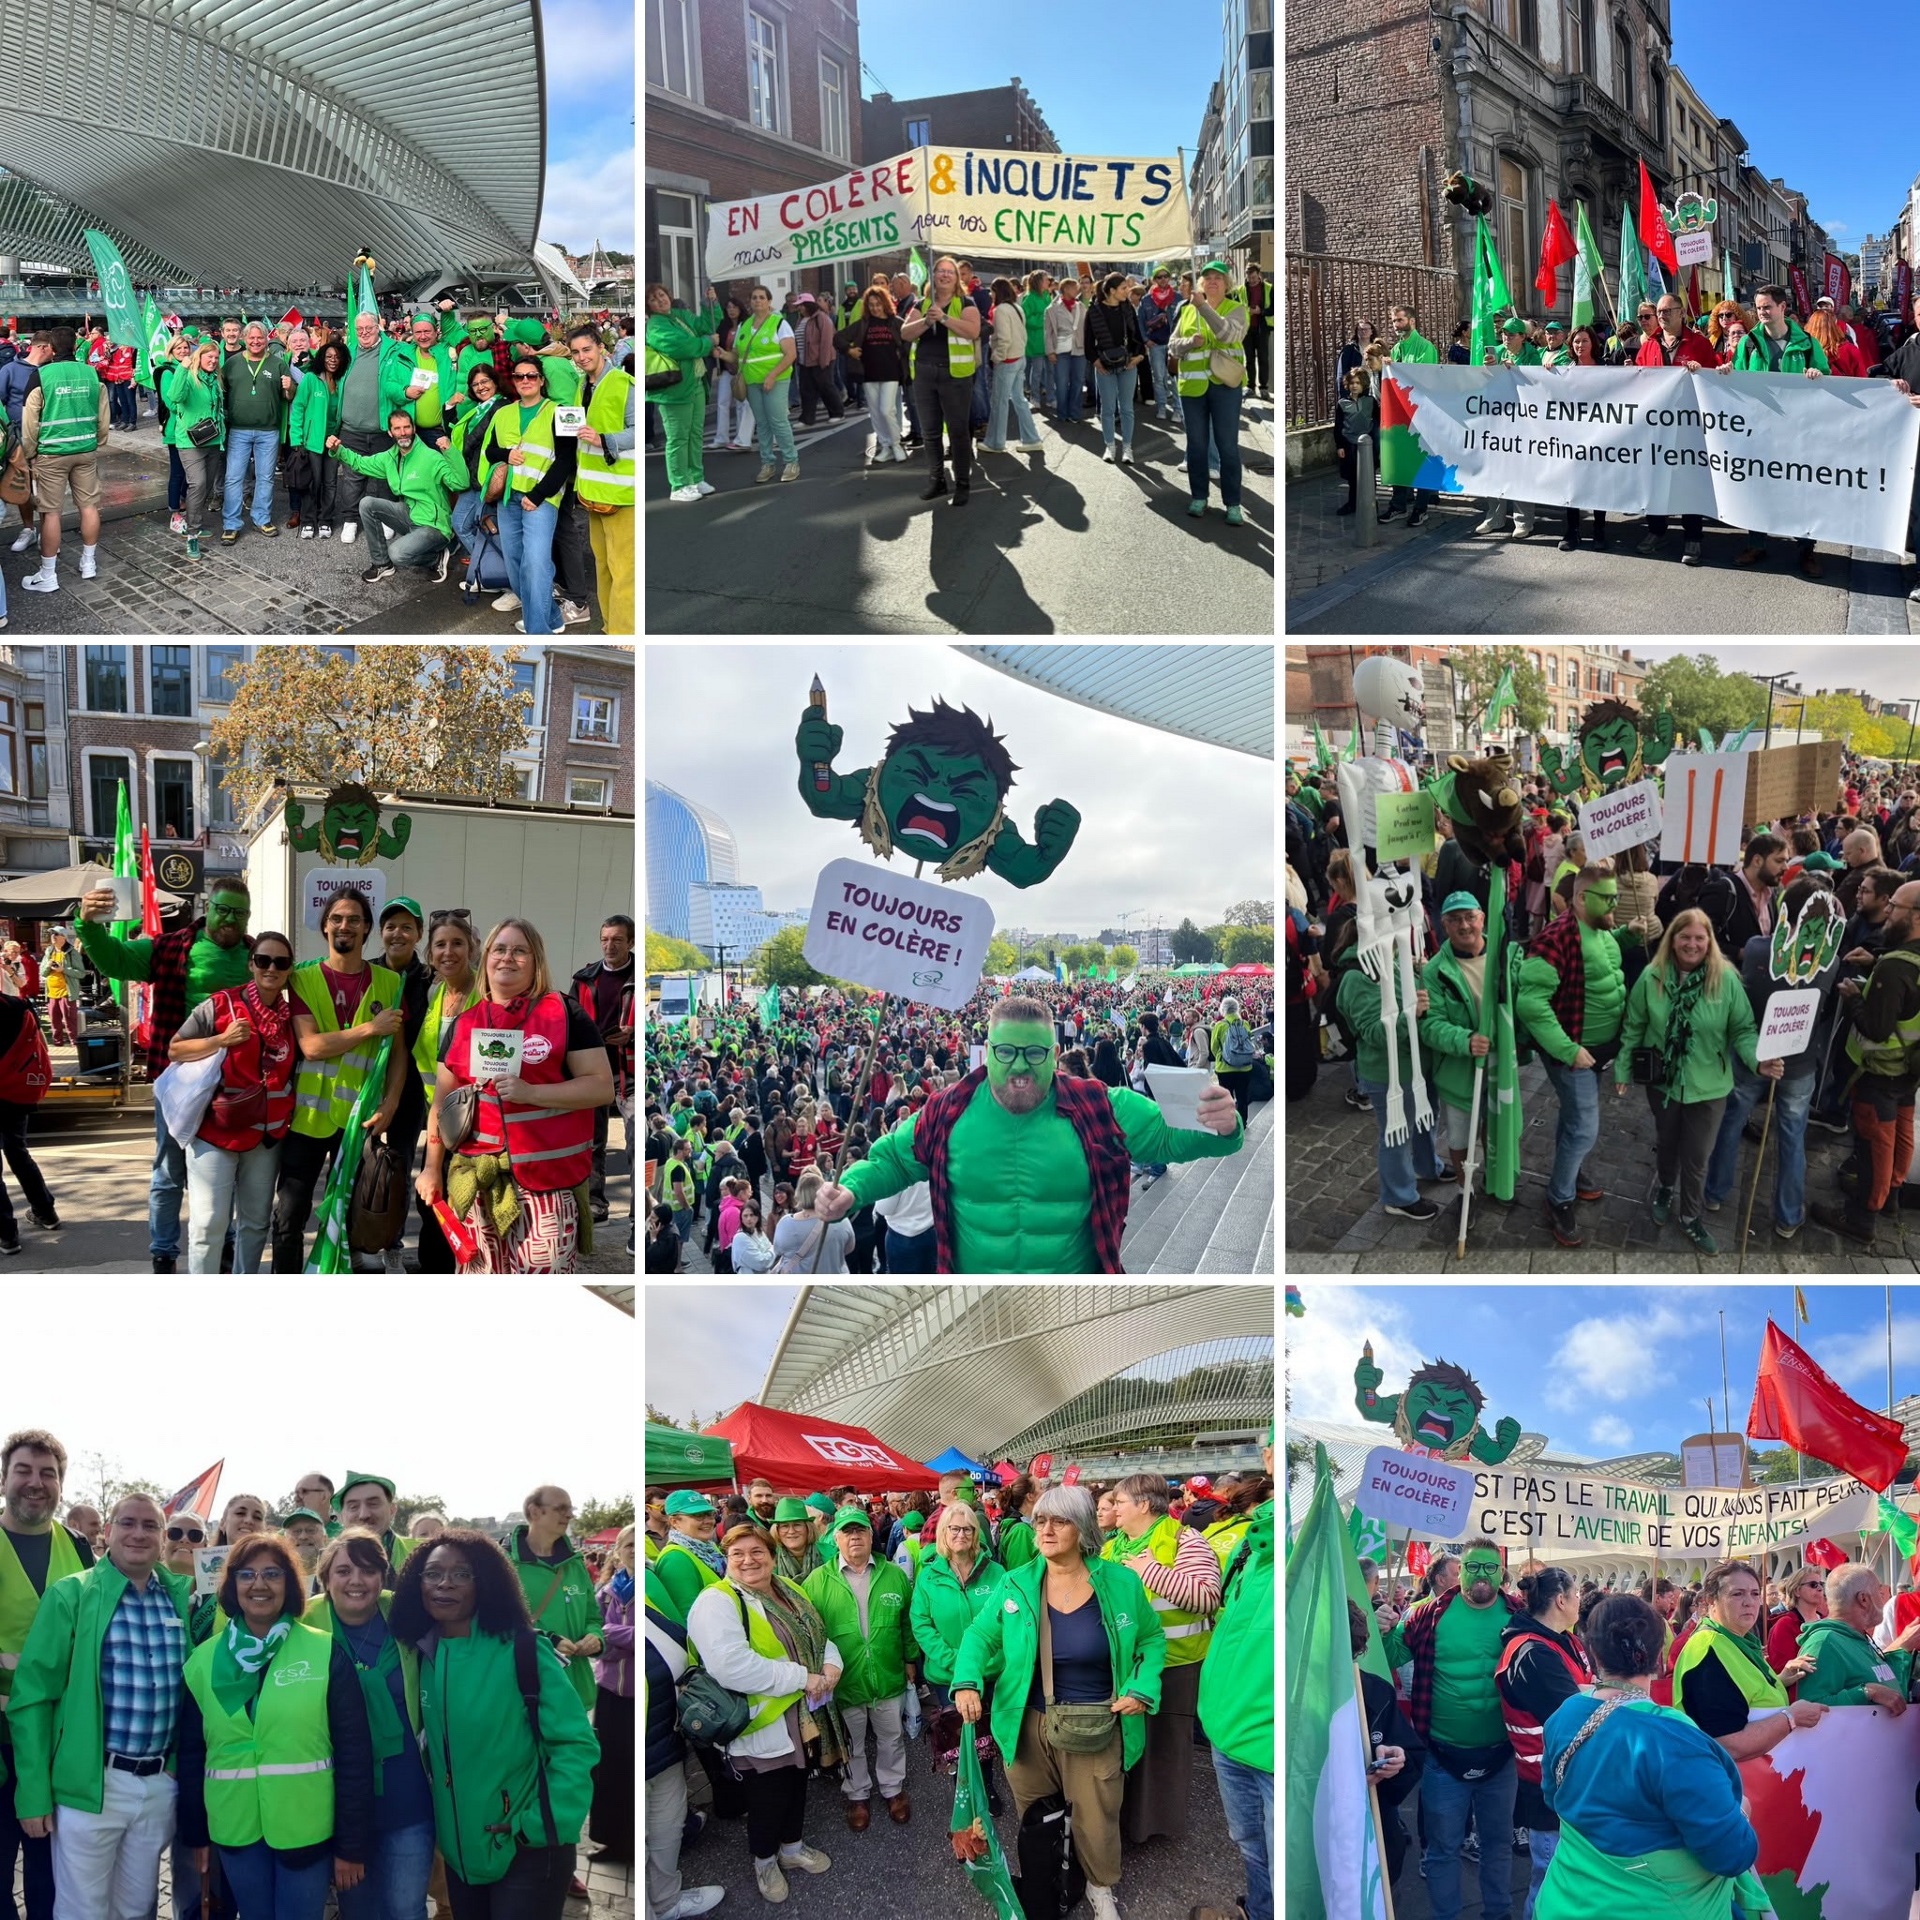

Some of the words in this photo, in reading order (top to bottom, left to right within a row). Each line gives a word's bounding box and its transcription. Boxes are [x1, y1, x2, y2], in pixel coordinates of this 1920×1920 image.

[728, 203, 759, 237] EN
[929, 153, 956, 195] &
[734, 245, 782, 268] mais
[789, 211, 899, 264] PRÉSENTS
[911, 213, 951, 240] pour
[959, 213, 987, 233] vos
[994, 208, 1145, 247] ENFANTS
[1830, 268, 1839, 294] CGSP
[1465, 395, 1538, 422] Chaque
[1545, 401, 1639, 425] ENFANT
[1645, 408, 1753, 437] compte,
[1463, 429, 1475, 449] Il
[1481, 430, 1522, 454] faut
[1528, 436, 1643, 464] refinancer
[1879, 467, 1886, 492] !
[1590, 793, 1646, 824] TOUJOURS
[1590, 826, 1604, 840] EN
[1606, 809, 1646, 834] COLÈRE
[1648, 807, 1652, 817] !
[843, 882, 964, 934] TOUJOURS
[827, 911, 857, 936] EN
[862, 922, 951, 963] COLÈRE
[954, 948, 963, 967] !
[1766, 1024, 1778, 1036] EN
[1778, 1019, 1805, 1034] COLÈRE
[1773, 1004, 1810, 1018] TOUJOURS
[1371, 1477, 1391, 1493] EN
[1394, 1485, 1450, 1509] COLÈRE
[1451, 1501, 1457, 1512] !
[1381, 1460, 1457, 1492] TOUJOURS
[1513, 1476, 1556, 1502] PAS
[1566, 1481, 1593, 1507] LE
[1602, 1485, 1675, 1516] TRAVAIL
[1685, 1494, 1717, 1518] QUI
[1721, 1494, 1763, 1517] NOUS
[1768, 1489, 1809, 1513] FAIT
[1480, 1509, 1548, 1536] C'EST
[1557, 1514, 1641, 1545] L'AVENIR
[1648, 1524, 1672, 1547] DE
[1682, 1525, 1721, 1548] VOS
